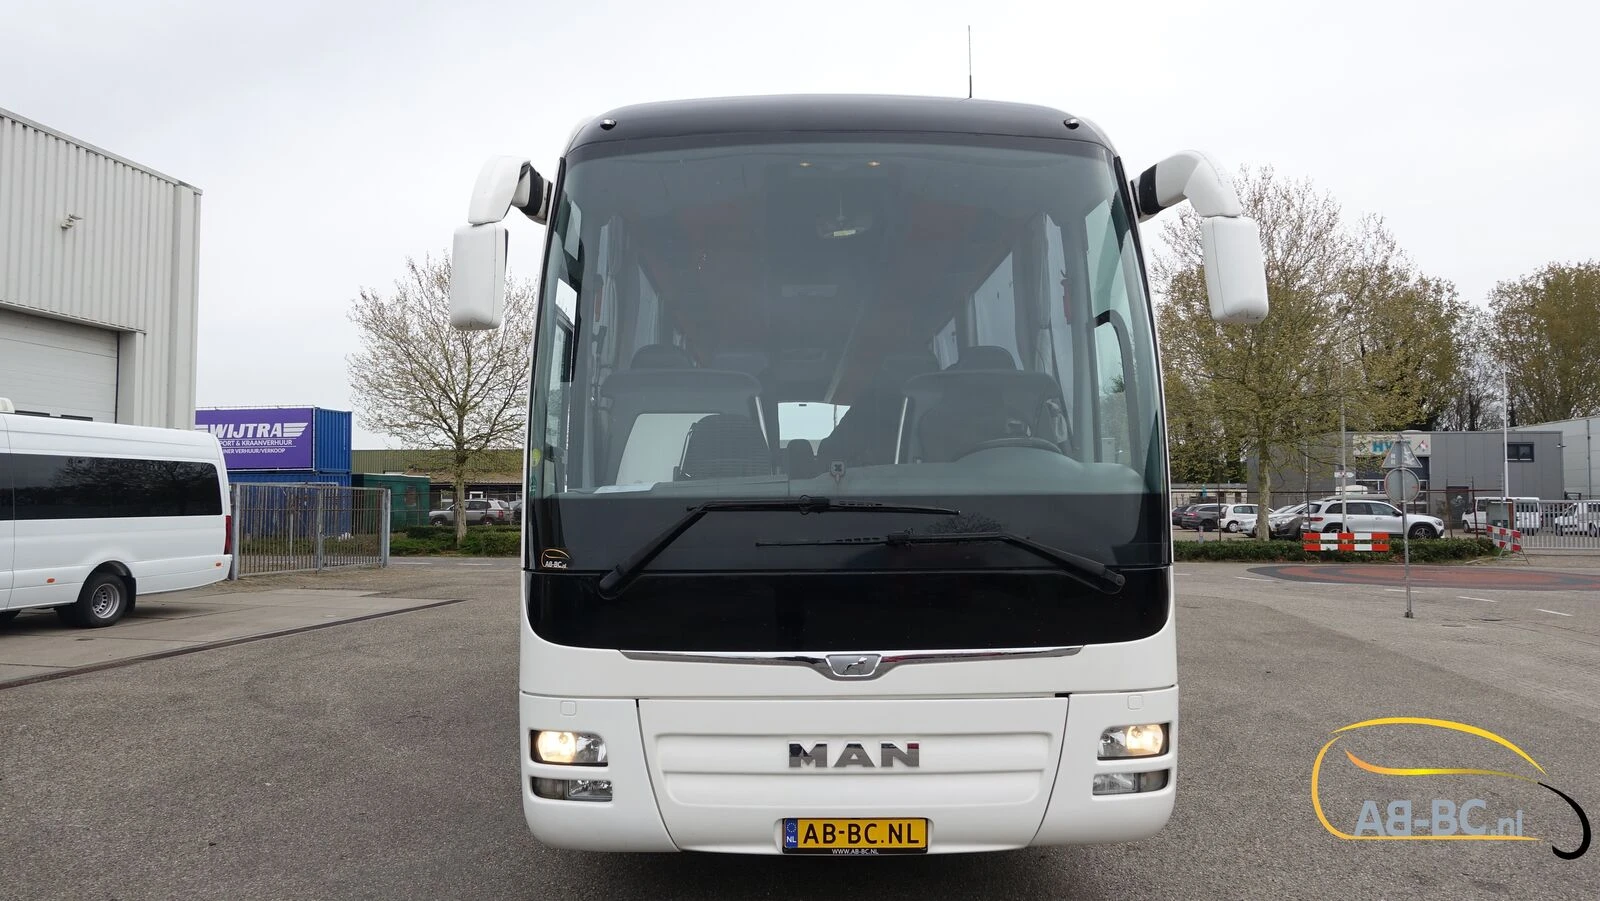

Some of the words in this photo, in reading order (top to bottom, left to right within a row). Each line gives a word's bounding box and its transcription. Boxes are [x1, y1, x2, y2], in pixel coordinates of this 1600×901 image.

[210, 423, 283, 438] WIJTRA
[788, 741, 920, 768] MAN
[803, 823, 920, 844] AB-BC.NL
